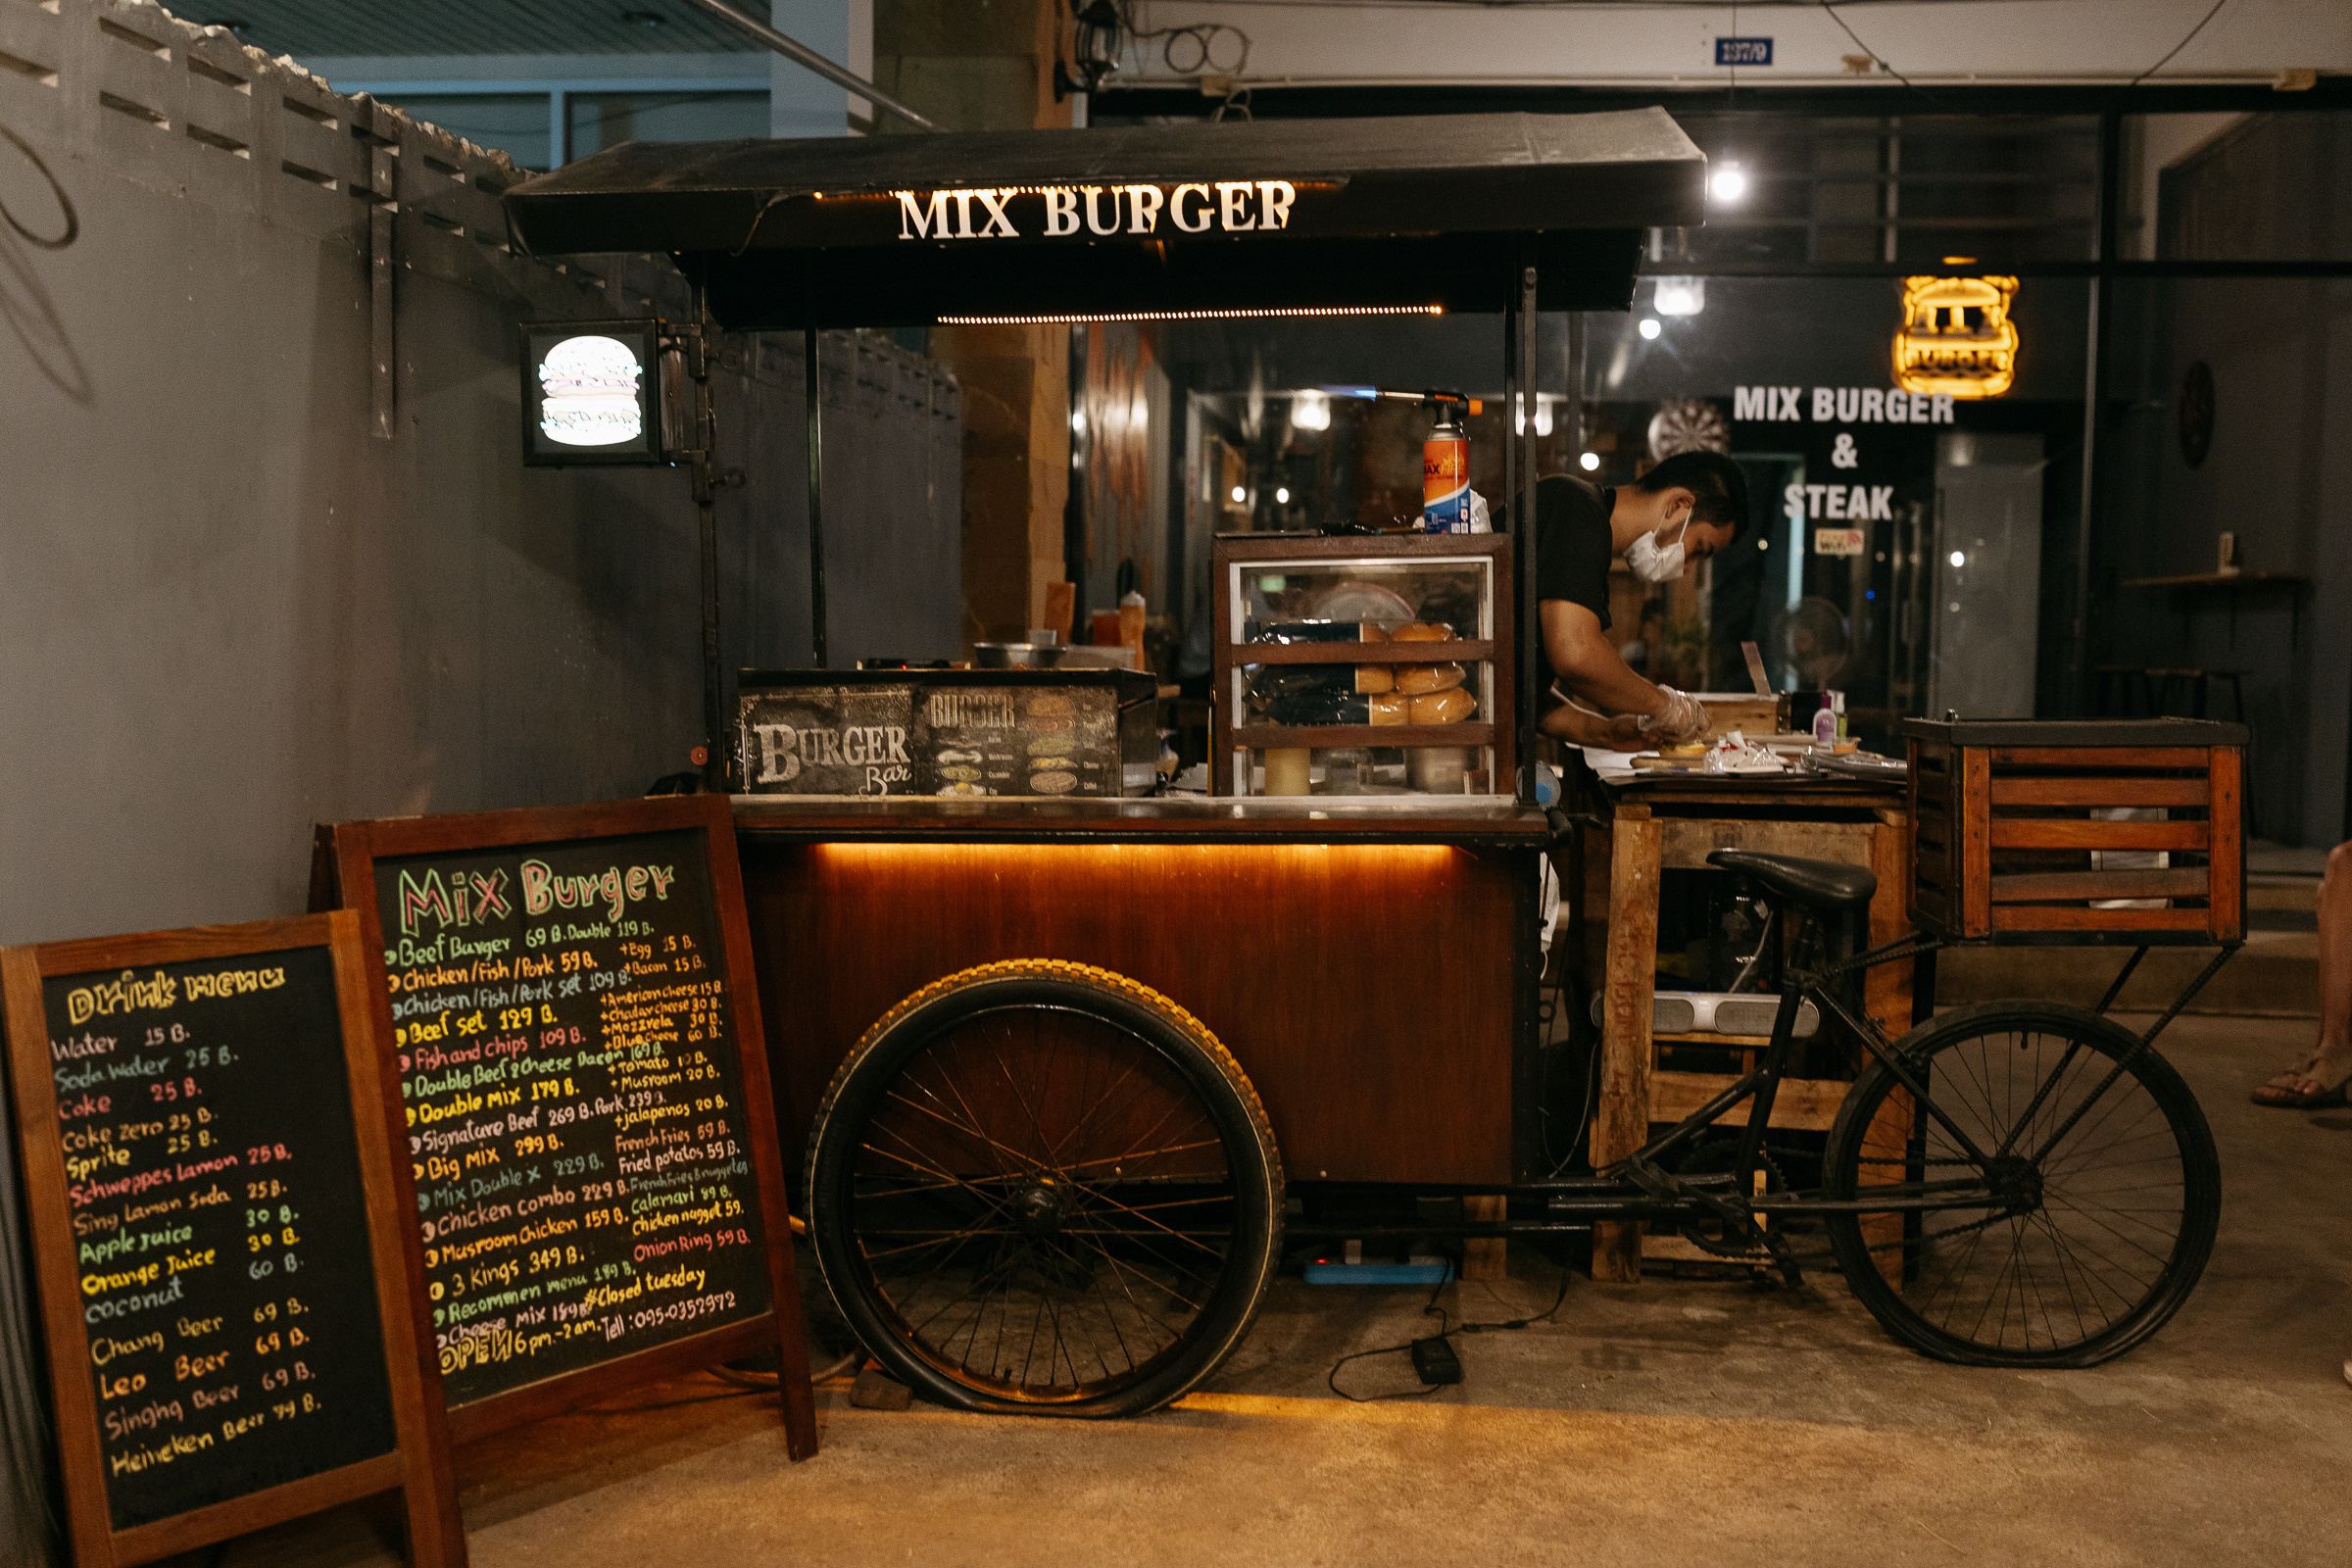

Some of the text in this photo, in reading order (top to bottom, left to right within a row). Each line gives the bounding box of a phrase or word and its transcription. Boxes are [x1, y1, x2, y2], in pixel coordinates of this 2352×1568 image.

[895, 180, 1297, 240] MIX BURGER
[1734, 386, 1955, 423] MIX BURGER
[1831, 432, 1858, 468] &
[1784, 483, 1894, 520] STEAK
[858, 764, 912, 798] Bar
[520, 858, 674, 923] Burger
[398, 933, 445, 967] Beef
[450, 937, 511, 961] Burger
[525, 929, 547, 949] 69
[568, 920, 611, 941] Double
[617, 920, 638, 938] 119
[561, 951, 580, 972] 59
[674, 956, 689, 972] 15
[559, 972, 582, 999] set
[589, 971, 614, 992] 109
[410, 1009, 451, 1044] Beef
[456, 1009, 488, 1036] set
[499, 1006, 532, 1031] 129
[688, 1029, 703, 1042] 60
[690, 1012, 705, 1028] 30
[50, 1031, 118, 1061] Water
[145, 1027, 165, 1047] 15
[185, 1047, 211, 1069] 25
[415, 1045, 449, 1071] Fish
[450, 1039, 480, 1063] and
[540, 1028, 566, 1050] 109
[416, 1069, 472, 1098] Double
[473, 1056, 509, 1085] Beef
[630, 1042, 650, 1060] 169
[686, 1067, 704, 1081] 20
[150, 1081, 177, 1102] 25
[418, 1092, 482, 1124] Double
[531, 1079, 560, 1102] 179
[696, 1098, 712, 1111] 20
[168, 1113, 192, 1132] 25
[422, 1119, 504, 1154] Signature
[508, 1105, 539, 1132] Beef
[548, 1106, 575, 1126] 269
[628, 1091, 652, 1107] 239
[614, 1128, 659, 1153] French
[660, 1127, 690, 1146] Fries
[698, 1122, 714, 1140] 59
[67, 1143, 130, 1181] Sprite
[167, 1134, 191, 1154] 25
[247, 1145, 271, 1165] 25
[427, 1156, 461, 1182] Big
[514, 1136, 544, 1156] 299
[618, 1149, 652, 1175] Fried
[707, 1141, 724, 1159] 59
[247, 1180, 269, 1200] 25
[470, 1168, 522, 1199] Double
[553, 1155, 586, 1176] 229
[437, 1201, 513, 1237] Chicken
[581, 1181, 612, 1201] 229
[519, 1217, 578, 1245] Chicken
[585, 1207, 610, 1228] 159
[79, 1226, 135, 1264] Apple
[247, 1208, 270, 1228] 30
[248, 1233, 272, 1252] 30
[634, 1237, 677, 1262] Onion
[678, 1232, 712, 1251] Ring
[717, 1229, 734, 1247] 59
[249, 1259, 273, 1280] 60
[452, 1273, 466, 1298] 3
[470, 1259, 519, 1292] Kings
[528, 1247, 561, 1274] 349
[594, 1263, 618, 1282] 189
[91, 1331, 165, 1366] Chang
[177, 1316, 223, 1337] Beer
[253, 1301, 277, 1323] 69
[438, 1323, 513, 1375] OPEN
[100, 1373, 147, 1400] Leo
[174, 1350, 230, 1382] Beer
[255, 1331, 281, 1355] 69
[192, 1385, 239, 1409] Beer
[262, 1368, 289, 1392] 69
